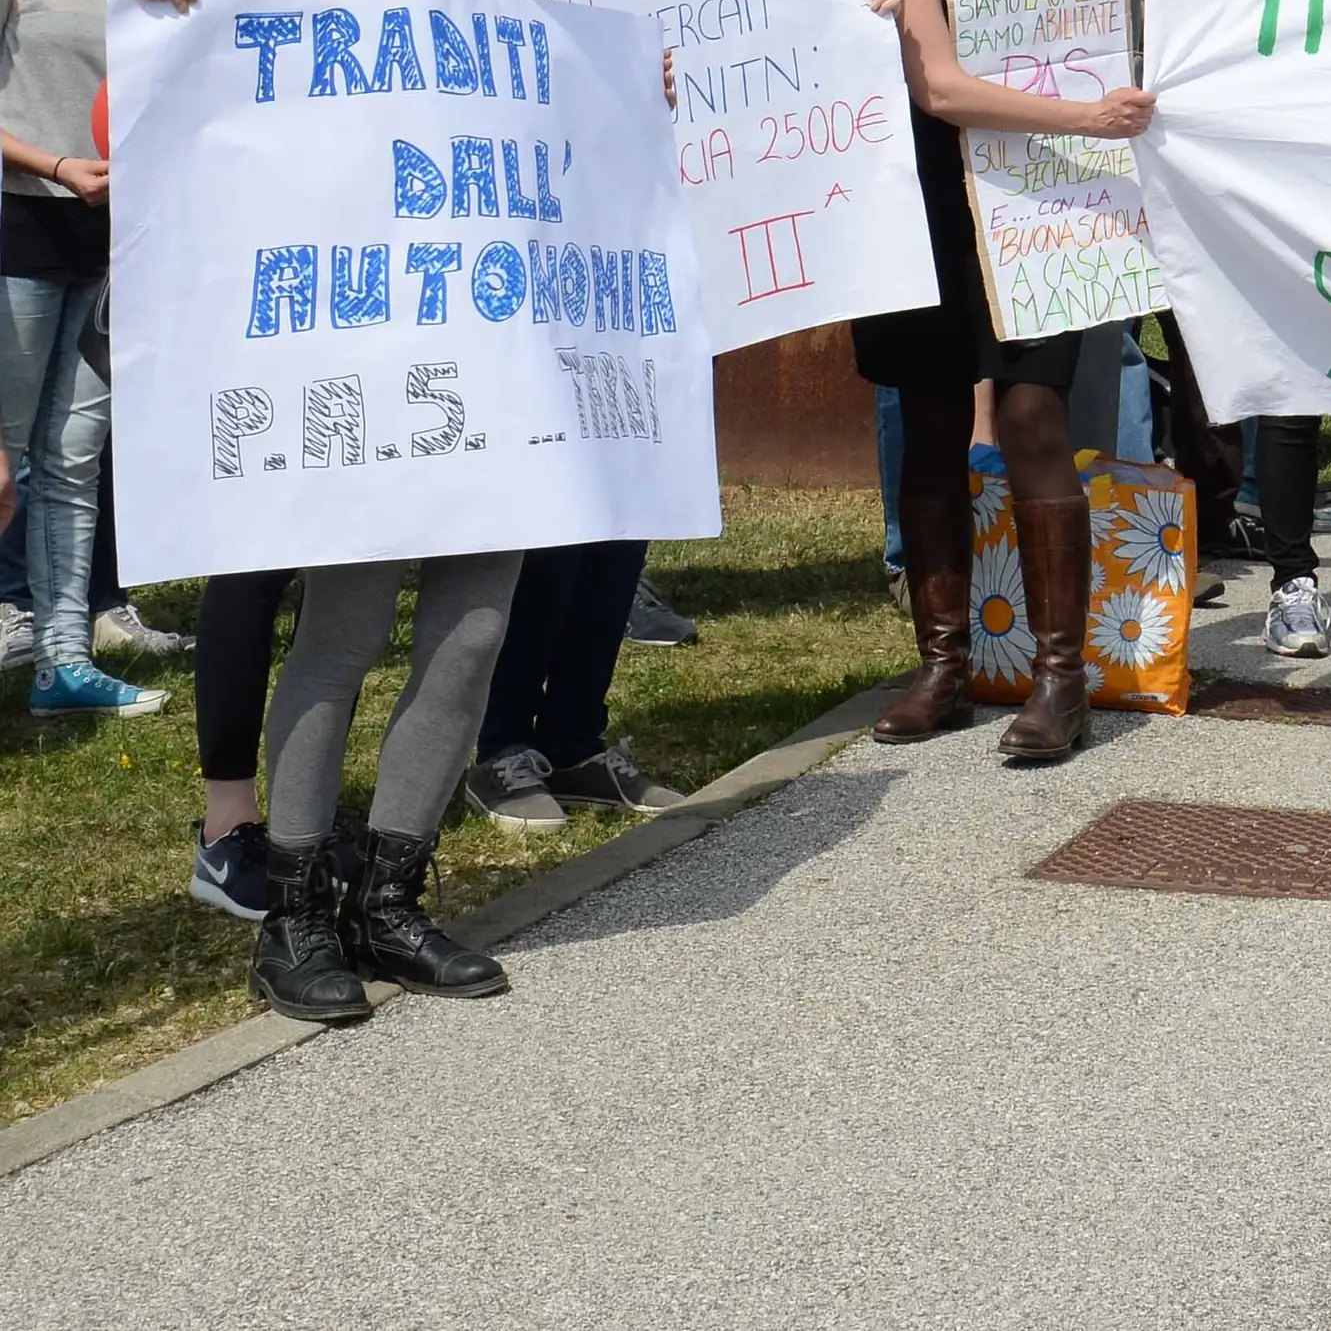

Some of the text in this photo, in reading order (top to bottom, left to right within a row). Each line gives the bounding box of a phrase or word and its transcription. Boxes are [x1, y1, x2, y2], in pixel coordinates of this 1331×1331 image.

[234, 7, 550, 105] TRADITI
[957, 0, 1123, 58] SIAMO ABILITATE
[756, 95, 893, 164] 2500€
[975, 139, 1014, 174] SUL
[393, 135, 572, 223] DALL'
[1002, 145, 1133, 197] SPECIALIZZATE
[1038, 196, 1076, 216] CON
[1084, 188, 1112, 210] LA
[246, 240, 677, 339] AUTONOMIA
[1010, 261, 1034, 294] A
[1043, 245, 1114, 289] CASA
[1011, 266, 1167, 337] MANDATE
[210, 361, 487, 480] P.A.S.
